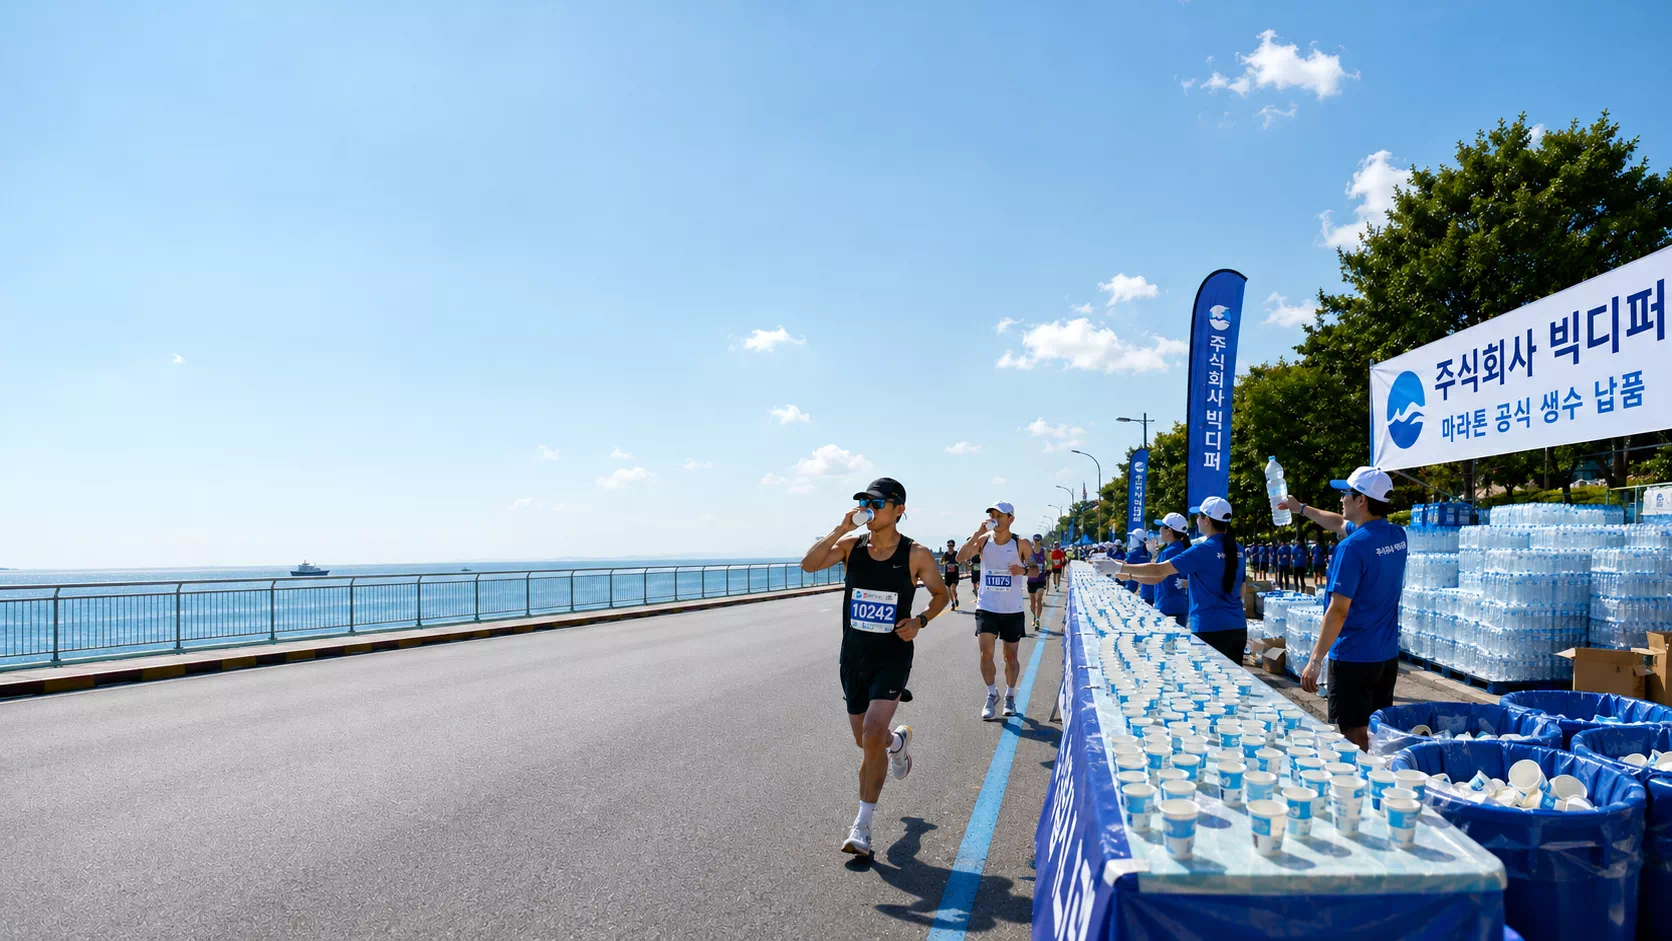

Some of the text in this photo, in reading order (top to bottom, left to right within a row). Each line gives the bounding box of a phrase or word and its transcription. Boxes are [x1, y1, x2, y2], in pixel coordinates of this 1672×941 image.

[1434, 278, 1665, 401] 주식회사 빅디퍼
[1203, 335, 1225, 471] 주식회사 빅디퍼
[1442, 370, 1645, 443] 마라톤 공식 생수 납품
[852, 603, 894, 621] 10242
